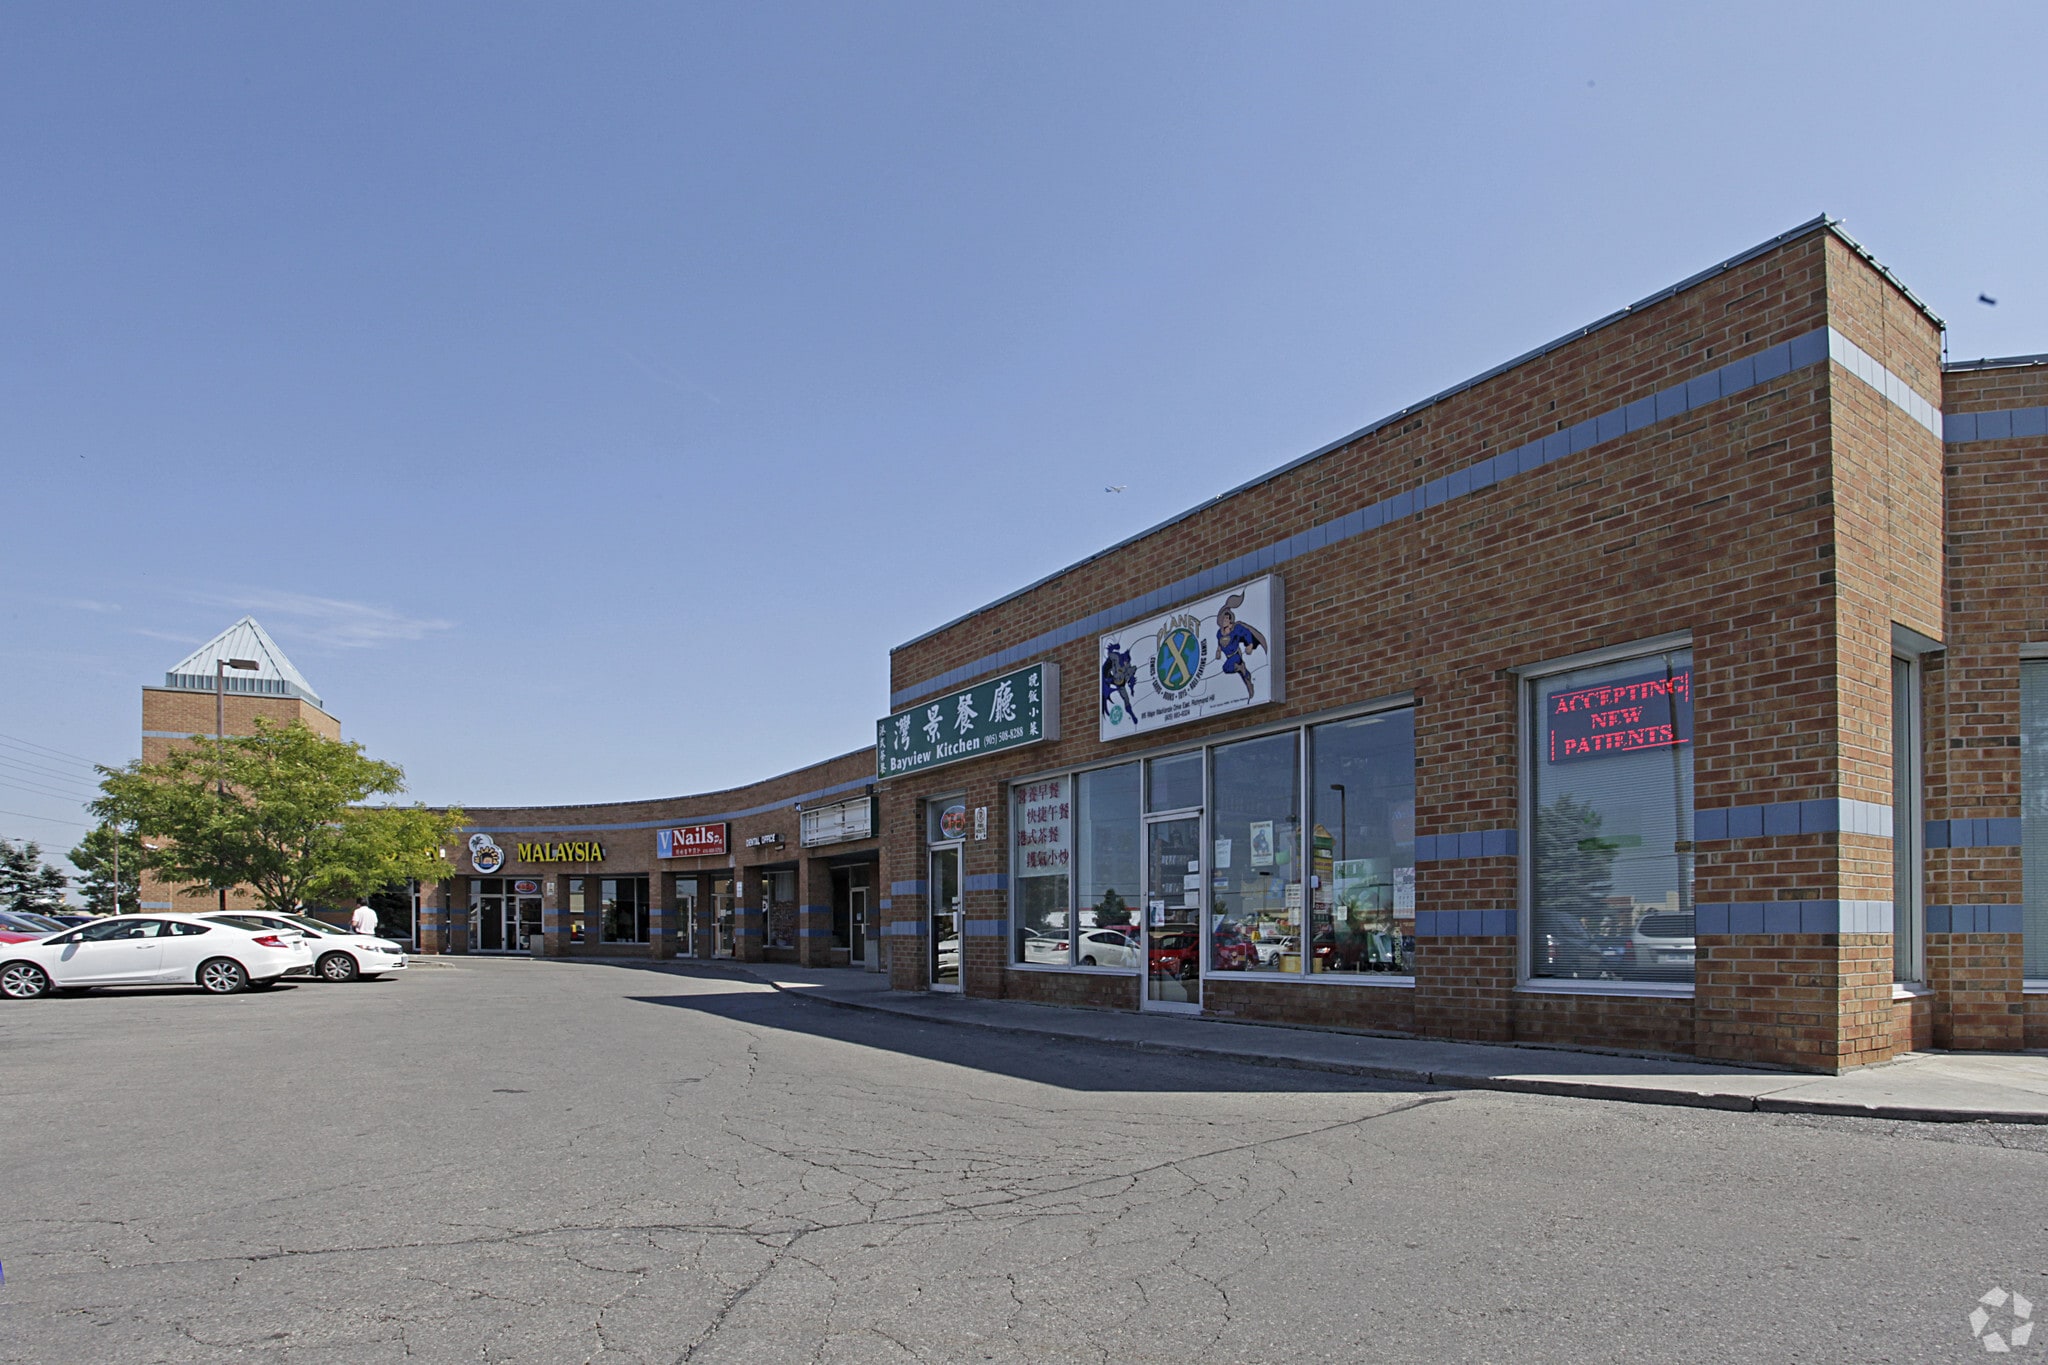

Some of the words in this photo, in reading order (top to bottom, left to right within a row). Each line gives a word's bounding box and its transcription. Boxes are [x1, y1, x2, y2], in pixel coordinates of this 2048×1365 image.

[1156, 613, 1201, 651] PLANET
[1164, 631, 1193, 687] X
[1028, 672, 1039, 736] 晚飯小菜
[1555, 675, 1686, 714] ACCEPTING
[893, 679, 1017, 751] 灣景餐廳
[1590, 705, 1643, 729] NEW
[890, 749, 931, 772] Bayview
[936, 736, 980, 760] Kitchen
[984, 733, 998, 748] (905)
[1564, 723, 1674, 755] PATIENTS
[1026, 803, 1069, 824] 快捷午餐
[517, 841, 604, 863] MALAYSIA
[659, 831, 671, 850] V
[673, 827, 714, 846] Nails
[1017, 826, 1059, 847] 港式茶餐
